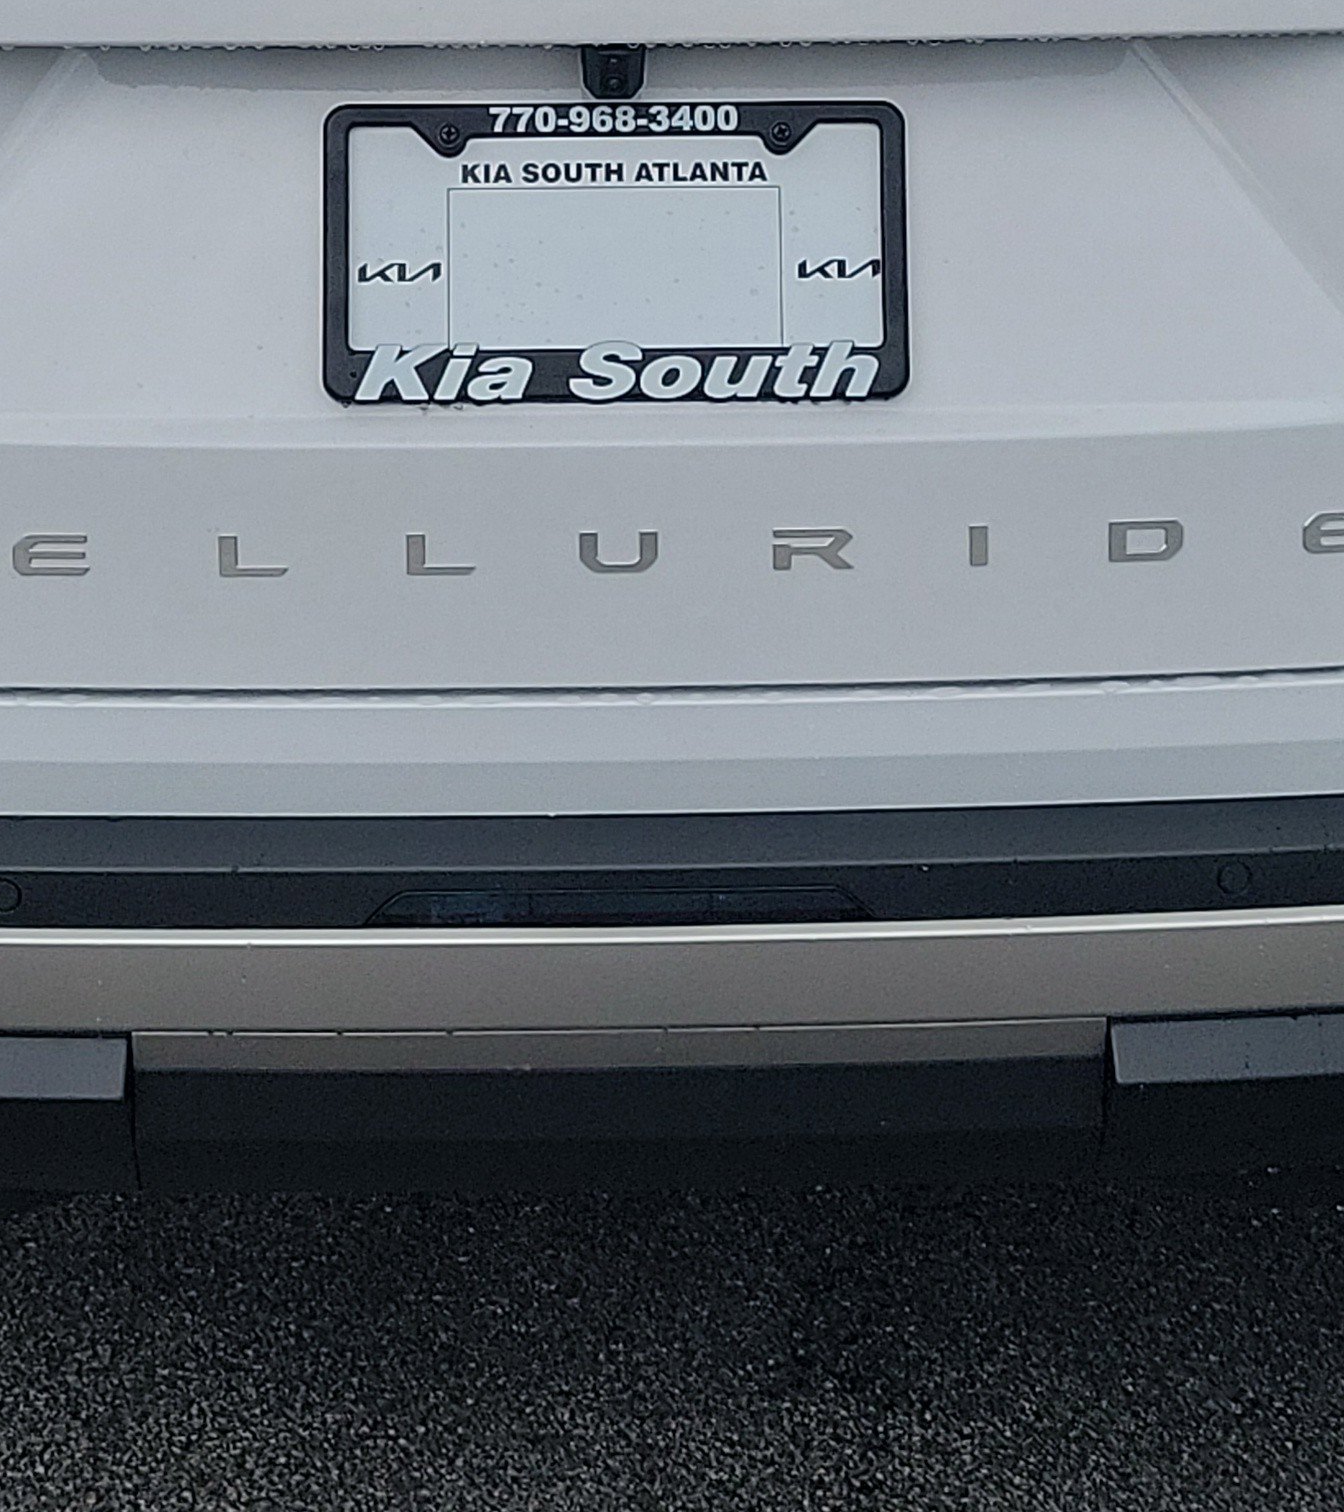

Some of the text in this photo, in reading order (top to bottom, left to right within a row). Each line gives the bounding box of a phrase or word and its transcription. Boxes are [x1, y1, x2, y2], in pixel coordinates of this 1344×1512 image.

[489, 106, 739, 133] 770-968-3400
[460, 160, 768, 184] KIA SOUTH ATLANTA
[357, 261, 442, 283] KIA
[797, 258, 881, 280] KIA
[355, 341, 880, 402] Kia South
